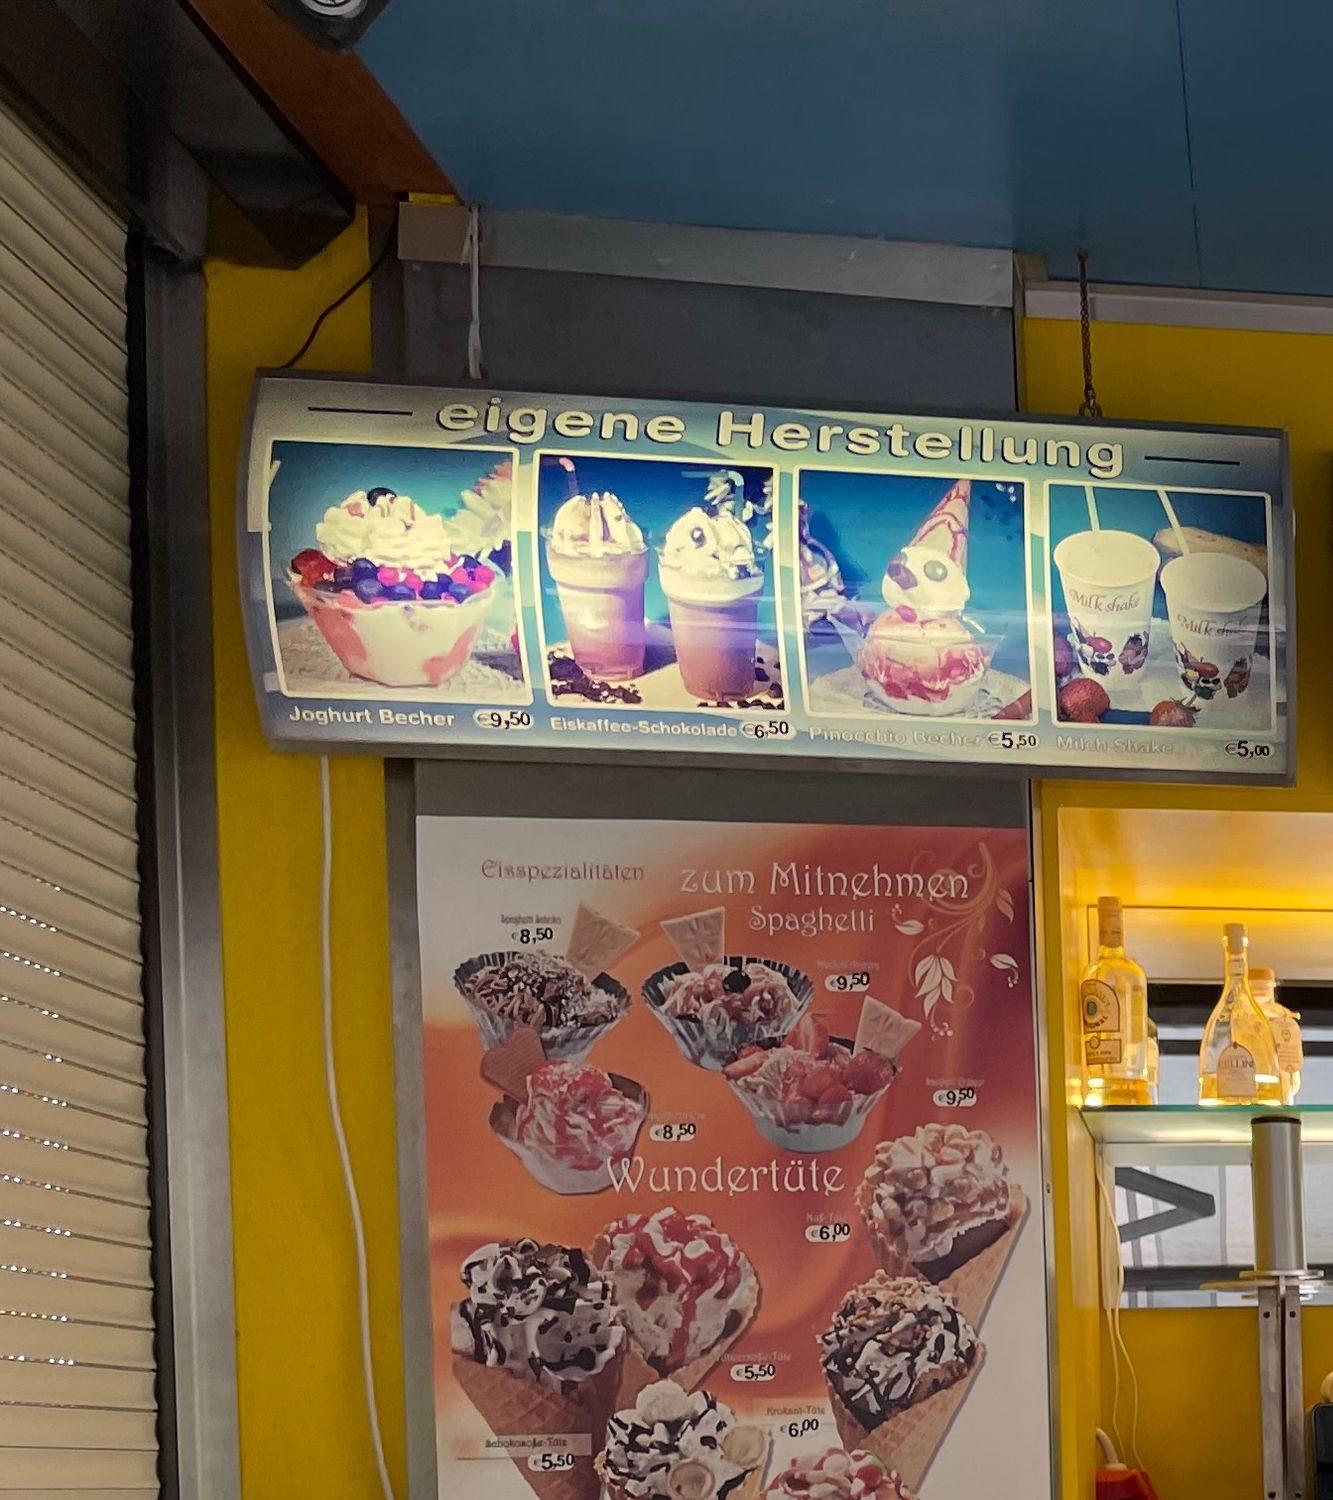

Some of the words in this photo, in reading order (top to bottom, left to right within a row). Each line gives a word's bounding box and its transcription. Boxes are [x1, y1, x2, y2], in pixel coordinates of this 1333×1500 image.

[437, 397, 686, 444] eigene
[717, 410, 1126, 478] Herstellung
[289, 706, 372, 727] Joghurt
[379, 709, 455, 728] Becher
[550, 716, 738, 738] Eiskaffee-Schokolade
[808, 726, 907, 746] Pinocchio
[913, 729, 983, 748] Becher
[987, 731, 1037, 750] €5,50
[1057, 735, 1108, 754] Milch
[1112, 737, 1175, 756] Shake
[1225, 740, 1270, 759] €5,00
[481, 858, 645, 885] Eisspezialitäten
[680, 865, 756, 896] zum
[769, 861, 970, 900] Mitnehmen
[748, 904, 876, 937] Spaghetti
[605, 1154, 846, 1197] Wundertüte
